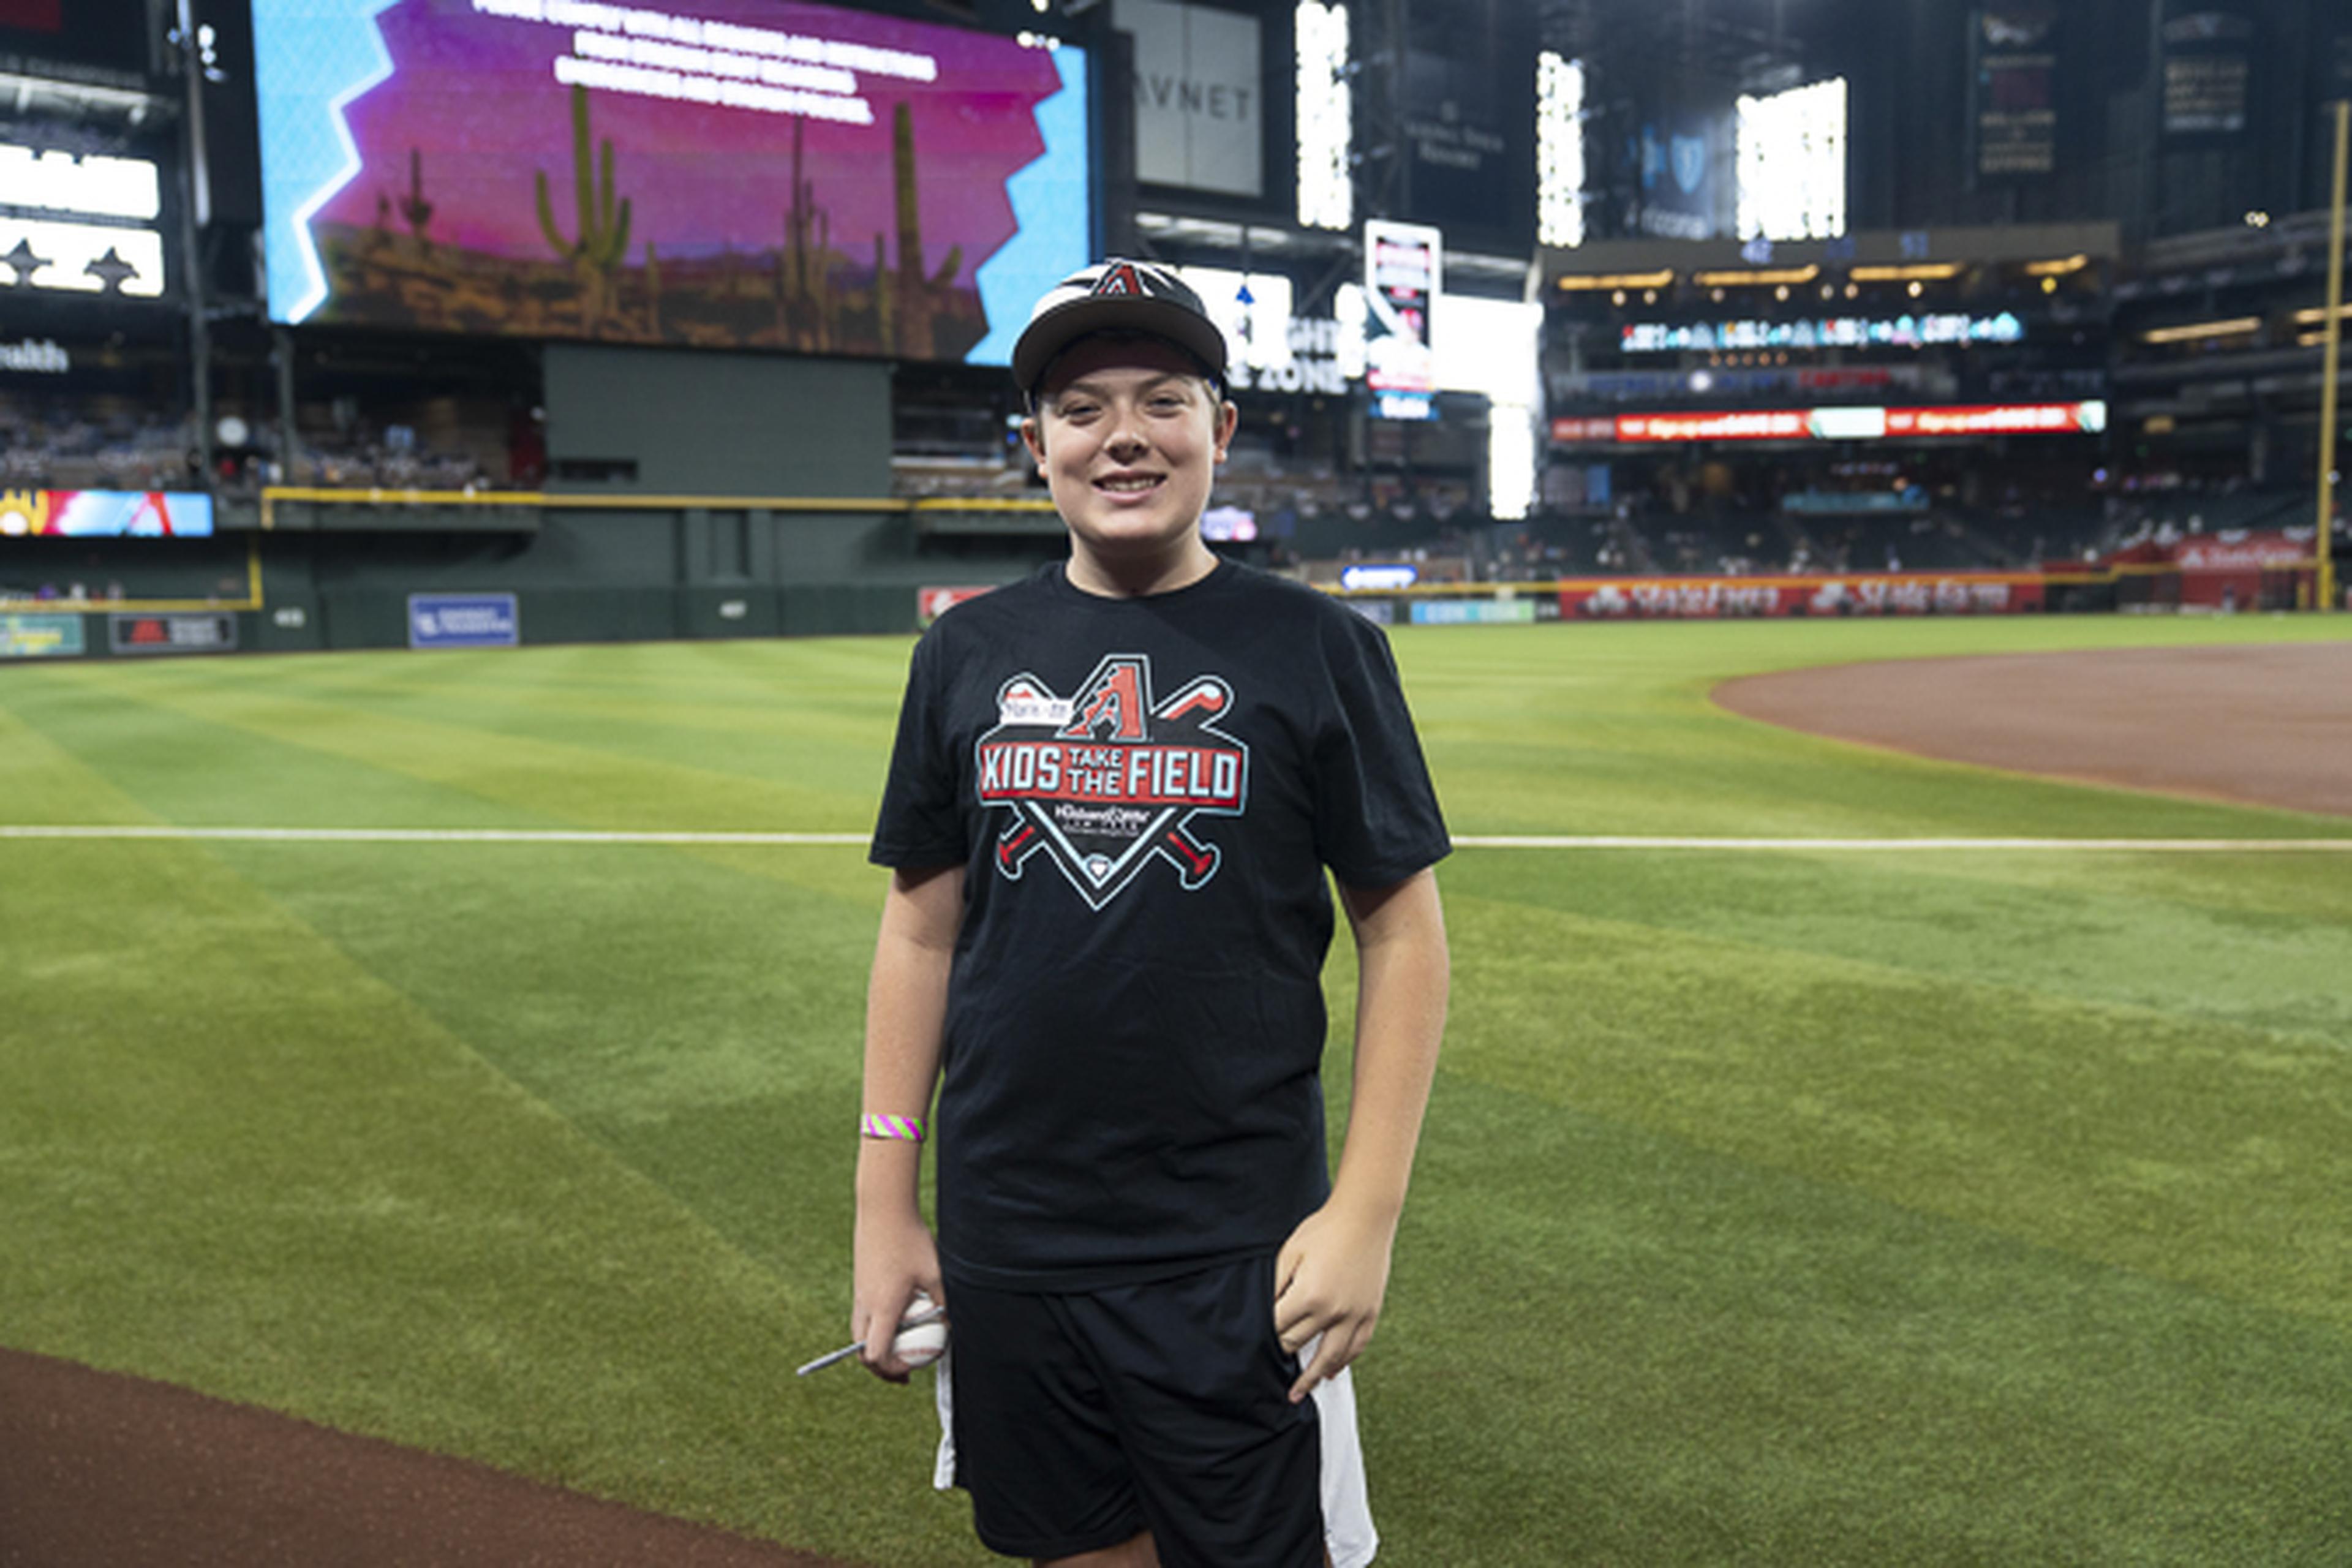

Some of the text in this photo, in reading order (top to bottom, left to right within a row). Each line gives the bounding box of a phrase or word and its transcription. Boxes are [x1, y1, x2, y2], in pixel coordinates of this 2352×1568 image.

[982, 745, 1238, 799] KIDS TAKE THE FIELD
